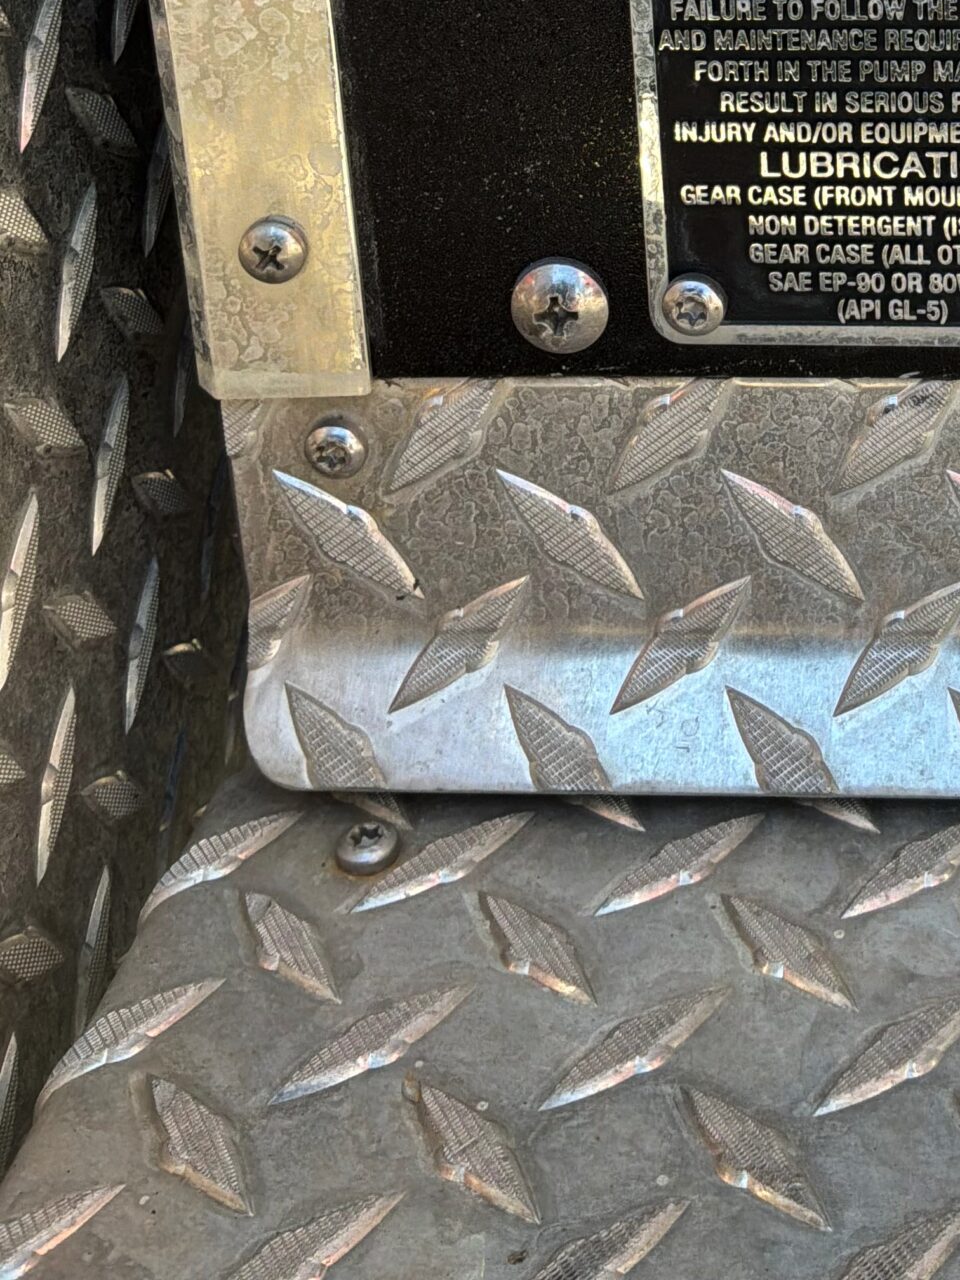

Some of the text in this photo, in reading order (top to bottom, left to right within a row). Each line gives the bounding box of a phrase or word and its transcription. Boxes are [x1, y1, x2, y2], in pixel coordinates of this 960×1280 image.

[670, 0, 766, 21] FAILURE
[772, 0, 802, 21] TO
[658, 30, 707, 51] AND
[713, 29, 877, 51] MAINTENANCE
[694, 60, 770, 82] FORTH
[777, 61, 800, 82] IN
[806, 60, 852, 82] THE
[859, 60, 925, 82] PUMP
[720, 91, 807, 113] RESULT
[814, 91, 838, 113] IN
[845, 91, 944, 113] SERIOUS
[674, 121, 754, 142] INJURY
[763, 121, 853, 142] AND/OR
[680, 185, 742, 207] GEAR
[747, 186, 807, 207] CASE
[814, 186, 897, 209] (FRONT
[748, 215, 796, 236] NON
[804, 216, 936, 237] DETERGENT
[749, 244, 809, 265] GEAR
[816, 244, 875, 266] CASE
[882, 245, 931, 268] (ALL
[769, 272, 814, 292] SAE
[819, 272, 885, 293] EP-90
[891, 273, 923, 293] OR
[837, 299, 948, 324] (API GL-5)
